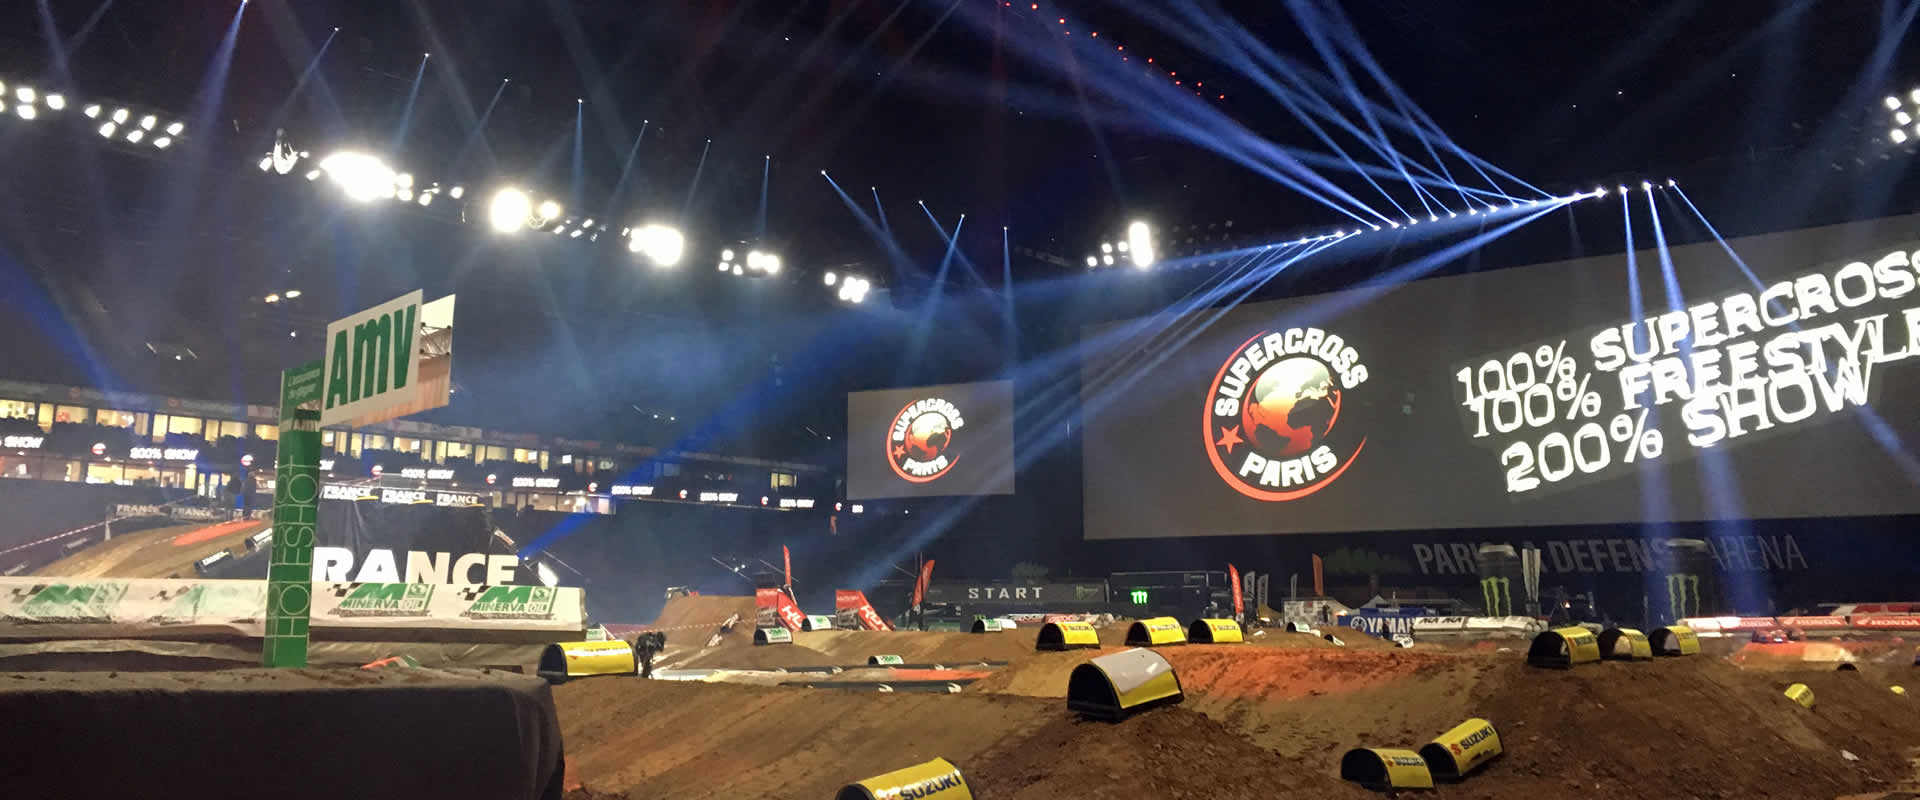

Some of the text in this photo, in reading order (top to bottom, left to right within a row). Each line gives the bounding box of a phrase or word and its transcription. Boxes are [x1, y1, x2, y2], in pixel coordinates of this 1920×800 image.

[1456, 250, 1920, 406] 100% SUPERCROS
[1214, 327, 1369, 417] SUPERCROSS
[892, 398, 965, 441] SUPERCROSS
[1470, 372, 1602, 438] 100%
[1501, 352, 1873, 493] 200% SHOW
[902, 454, 949, 476] PARIS
[1238, 445, 1338, 488] PARIS
[436, 493, 478, 504] FRANCE
[311, 546, 519, 586] RANCE
[1546, 537, 1676, 573] DEFENS
[339, 599, 399, 609] MINERVA
[471, 601, 525, 612] MINERVA
[968, 587, 1043, 599] START
[1460, 725, 1495, 750] SUZUKI
[899, 772, 962, 800] SUZUKI
